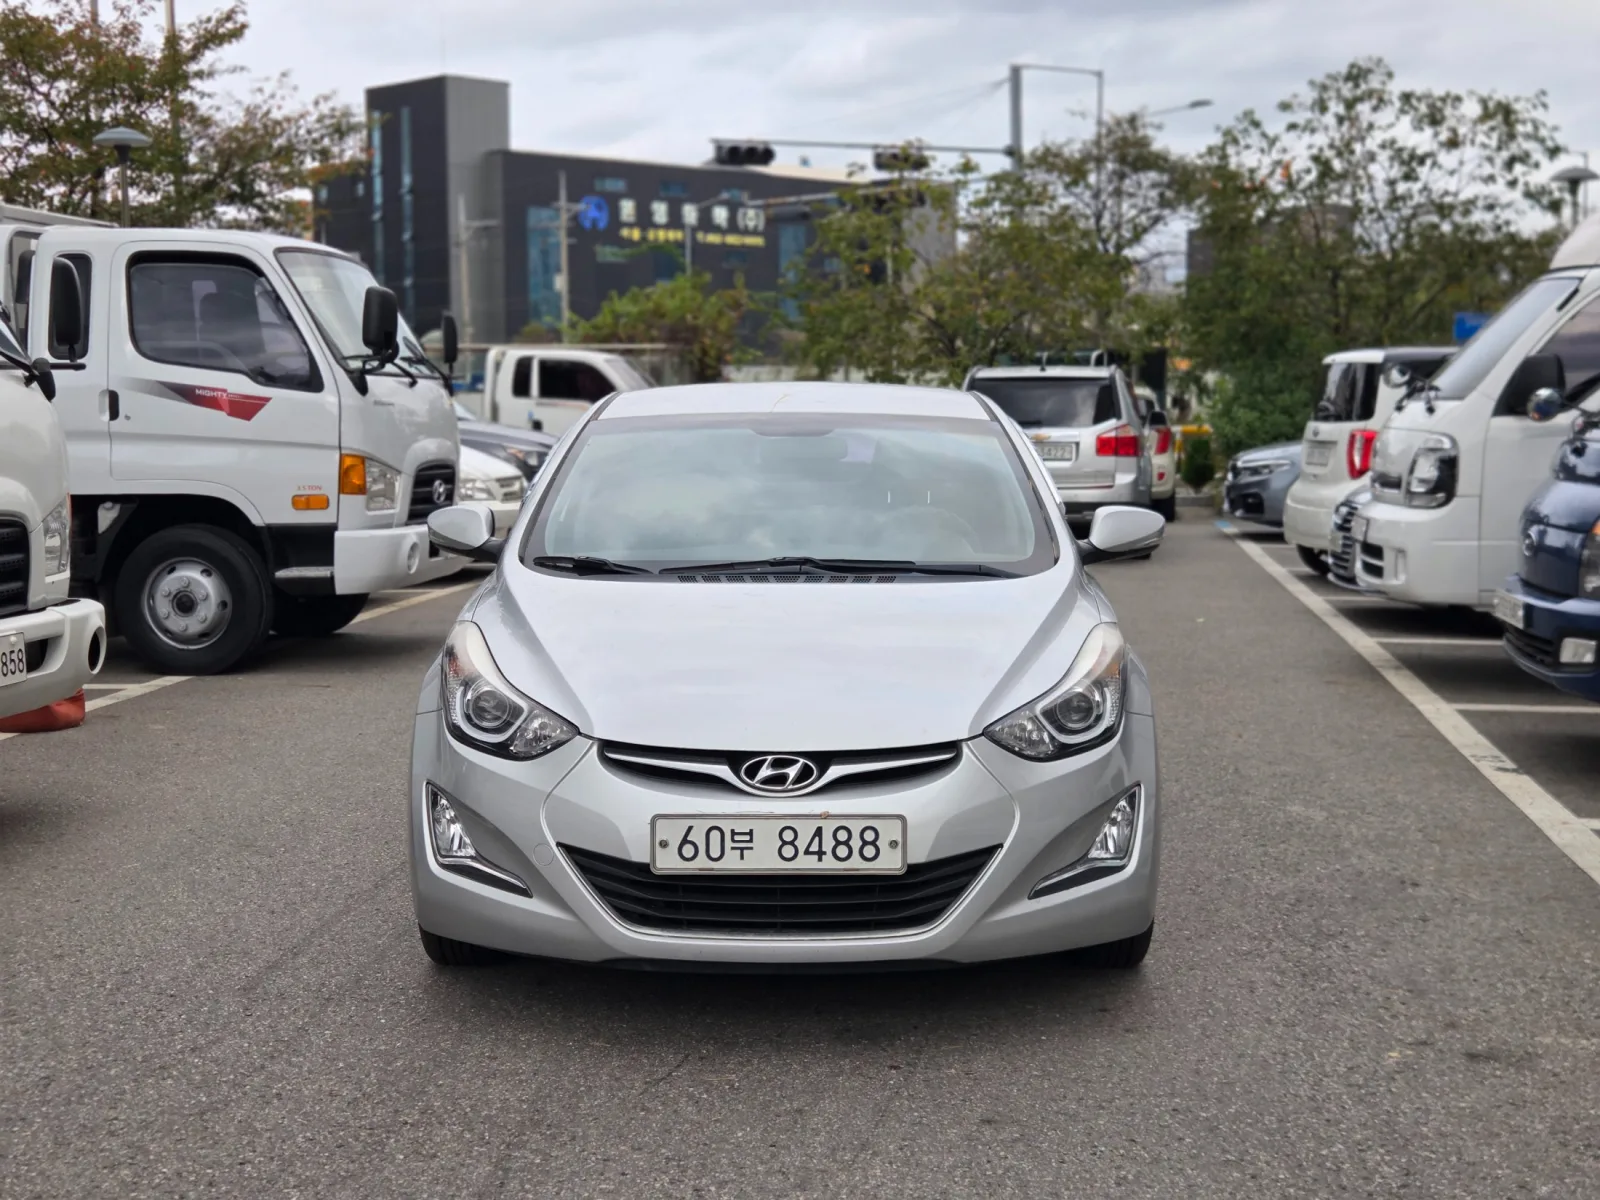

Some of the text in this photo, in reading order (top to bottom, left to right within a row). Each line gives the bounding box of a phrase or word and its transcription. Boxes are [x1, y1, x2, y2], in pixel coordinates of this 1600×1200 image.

[195, 387, 228, 399] MIGHTY
[1, 648, 25, 678] 858
[677, 825, 881, 863] 60부 8488
